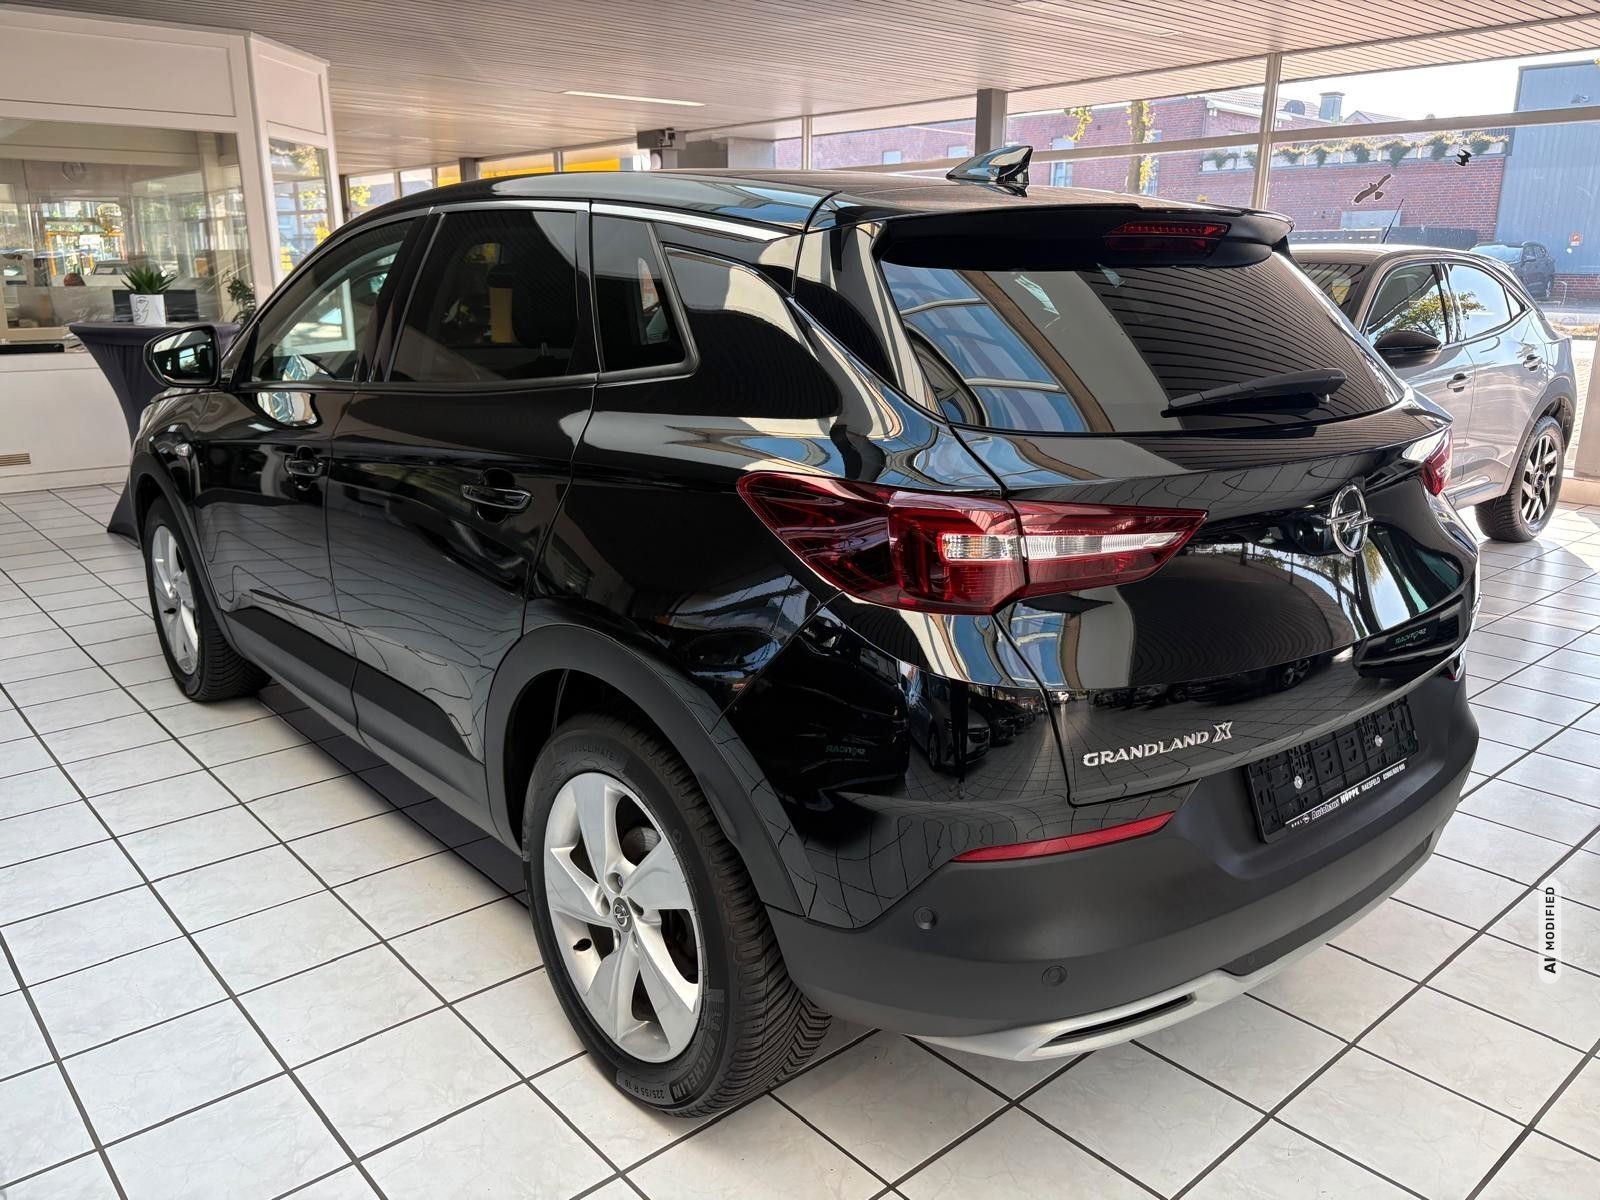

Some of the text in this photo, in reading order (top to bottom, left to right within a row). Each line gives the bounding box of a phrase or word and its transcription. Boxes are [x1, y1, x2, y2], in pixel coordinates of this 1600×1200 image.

[1083, 721, 1233, 767] GRANDLAND X
[671, 1032, 717, 1100] MICHELIN
